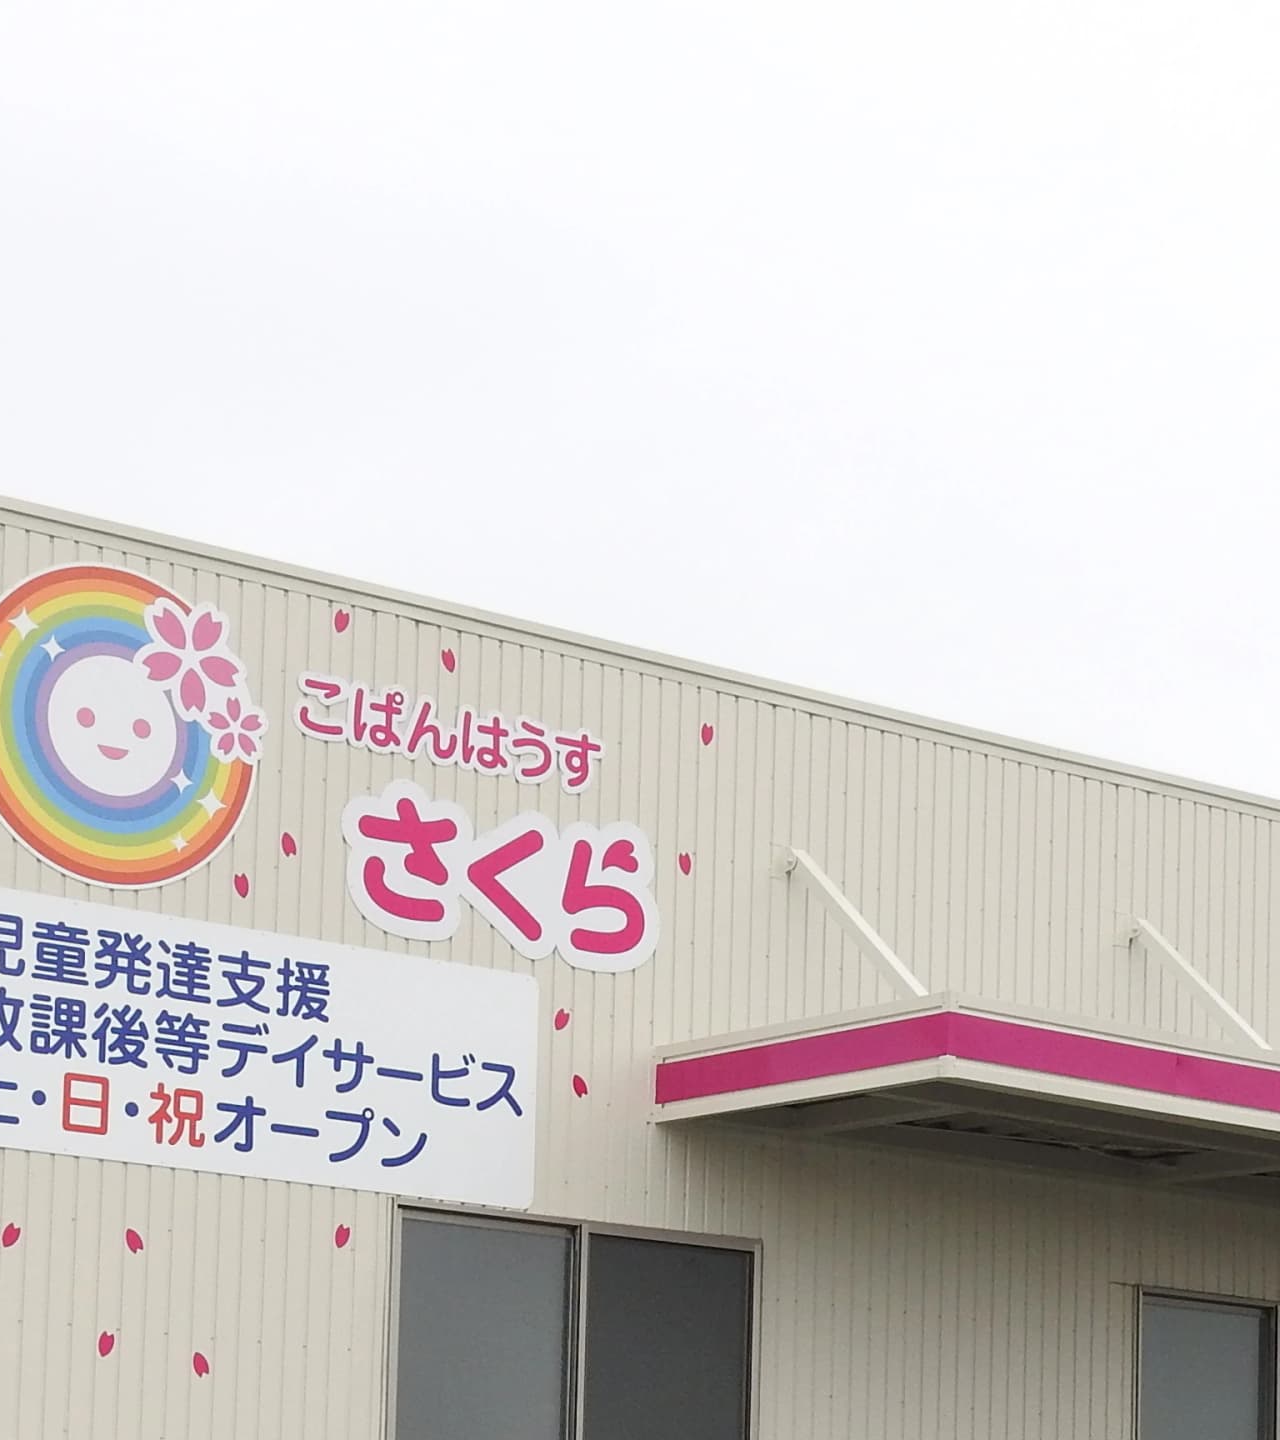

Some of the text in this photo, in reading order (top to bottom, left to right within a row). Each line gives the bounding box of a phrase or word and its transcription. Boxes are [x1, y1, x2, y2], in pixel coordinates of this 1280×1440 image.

[298, 678, 602, 788] こぱんはうす
[358, 797, 646, 954] さくら
